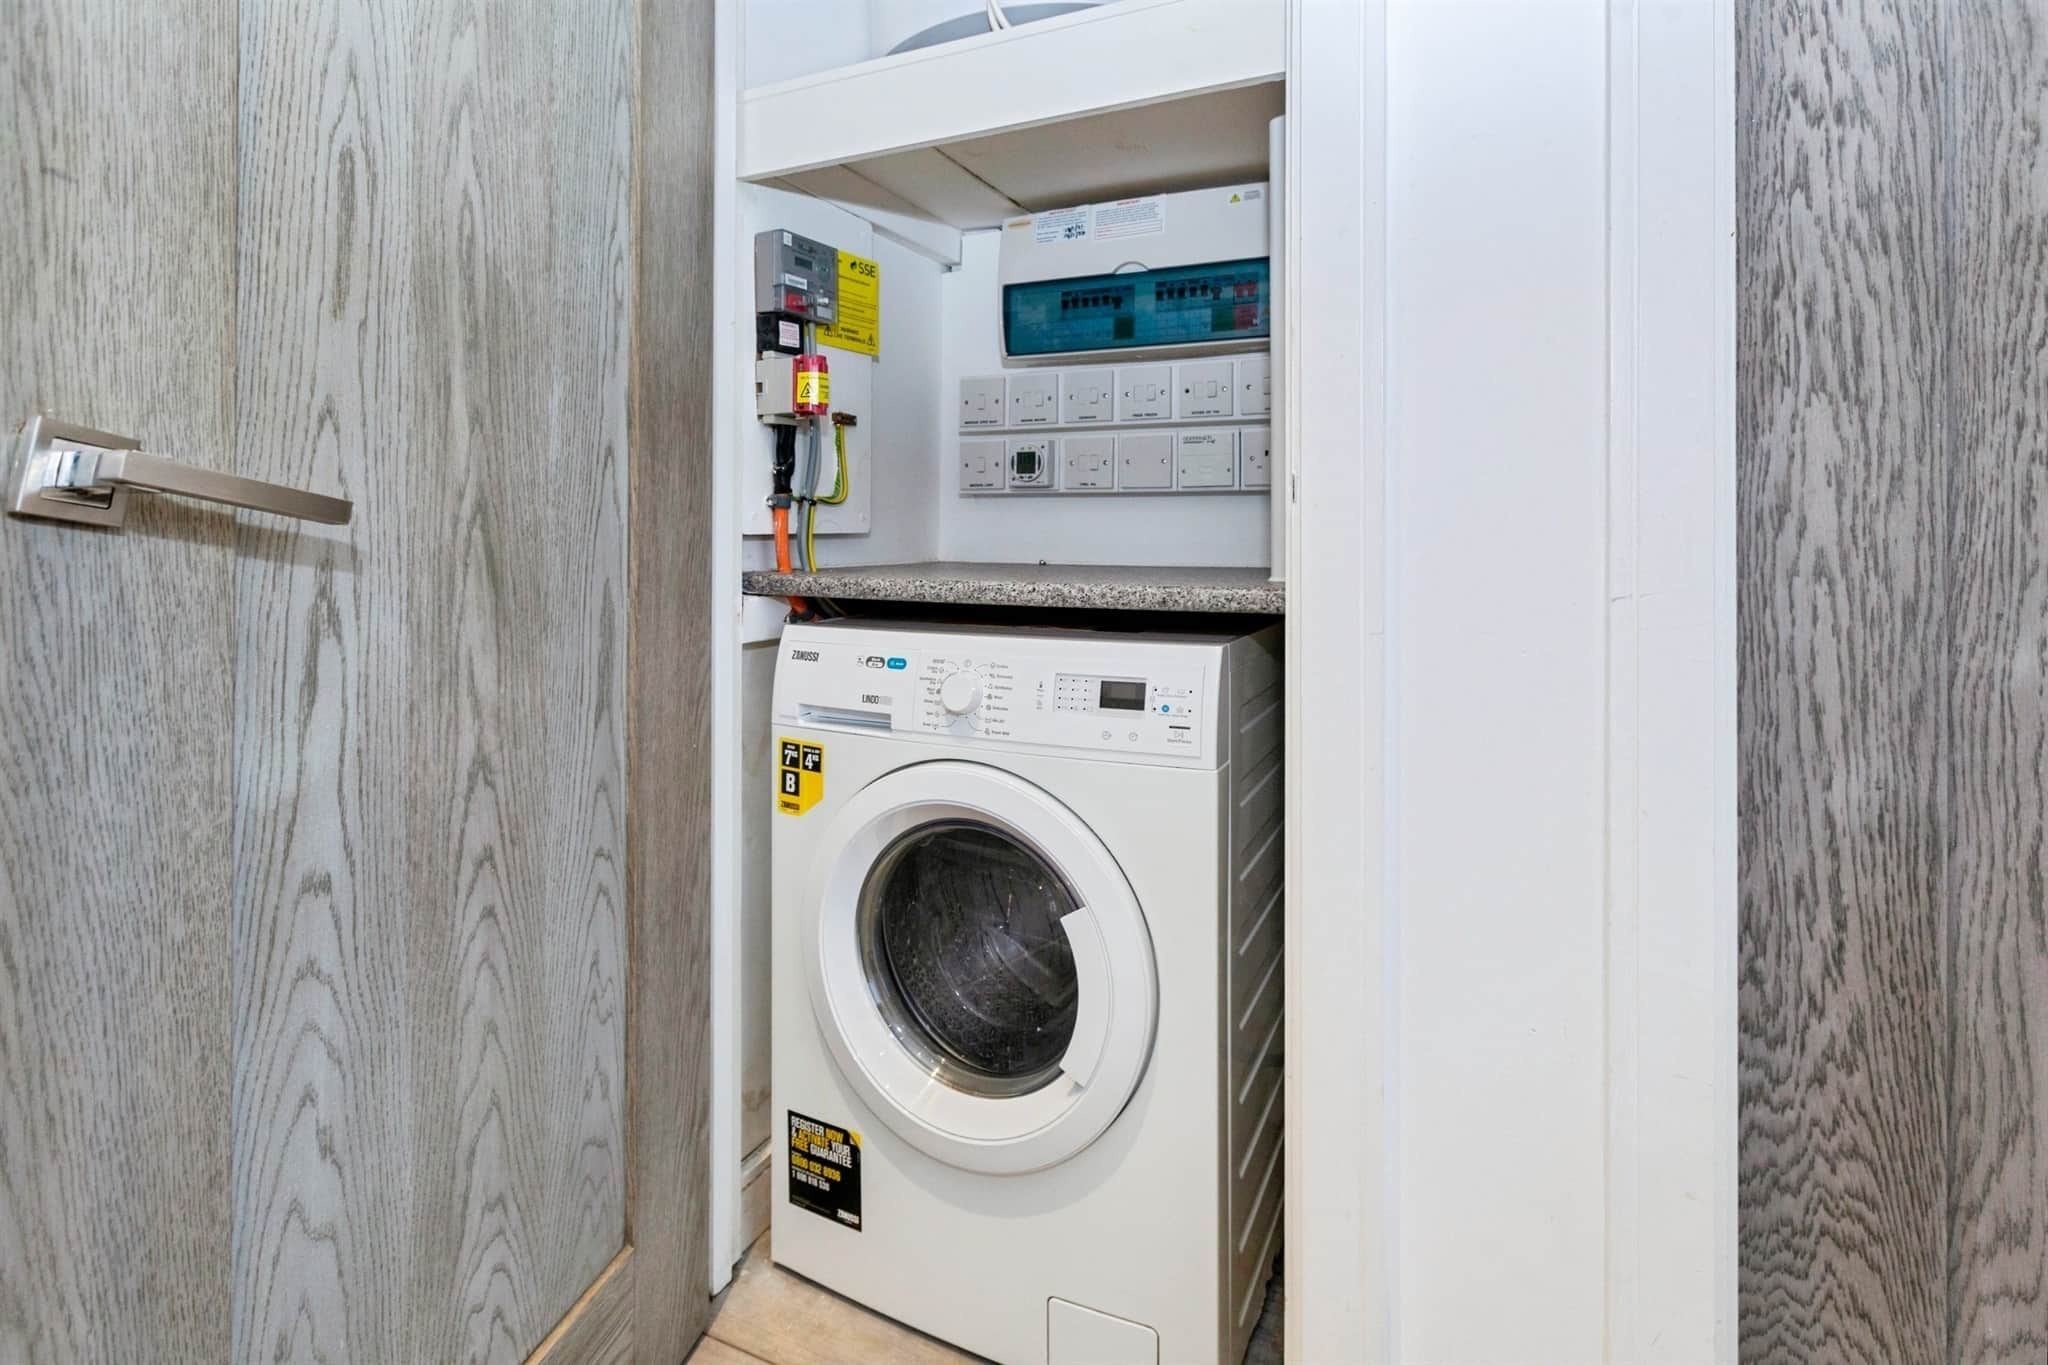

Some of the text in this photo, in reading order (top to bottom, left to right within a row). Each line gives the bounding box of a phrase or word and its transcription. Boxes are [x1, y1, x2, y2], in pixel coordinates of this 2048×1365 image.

[858, 261, 876, 278] SSE
[791, 650, 819, 662] ZANUSSI
[786, 773, 795, 793] B
[791, 1116, 824, 1136] REGISTER
[791, 1136, 852, 1168] FREE GUARANTEE
[831, 1141, 851, 1157] YOUR
